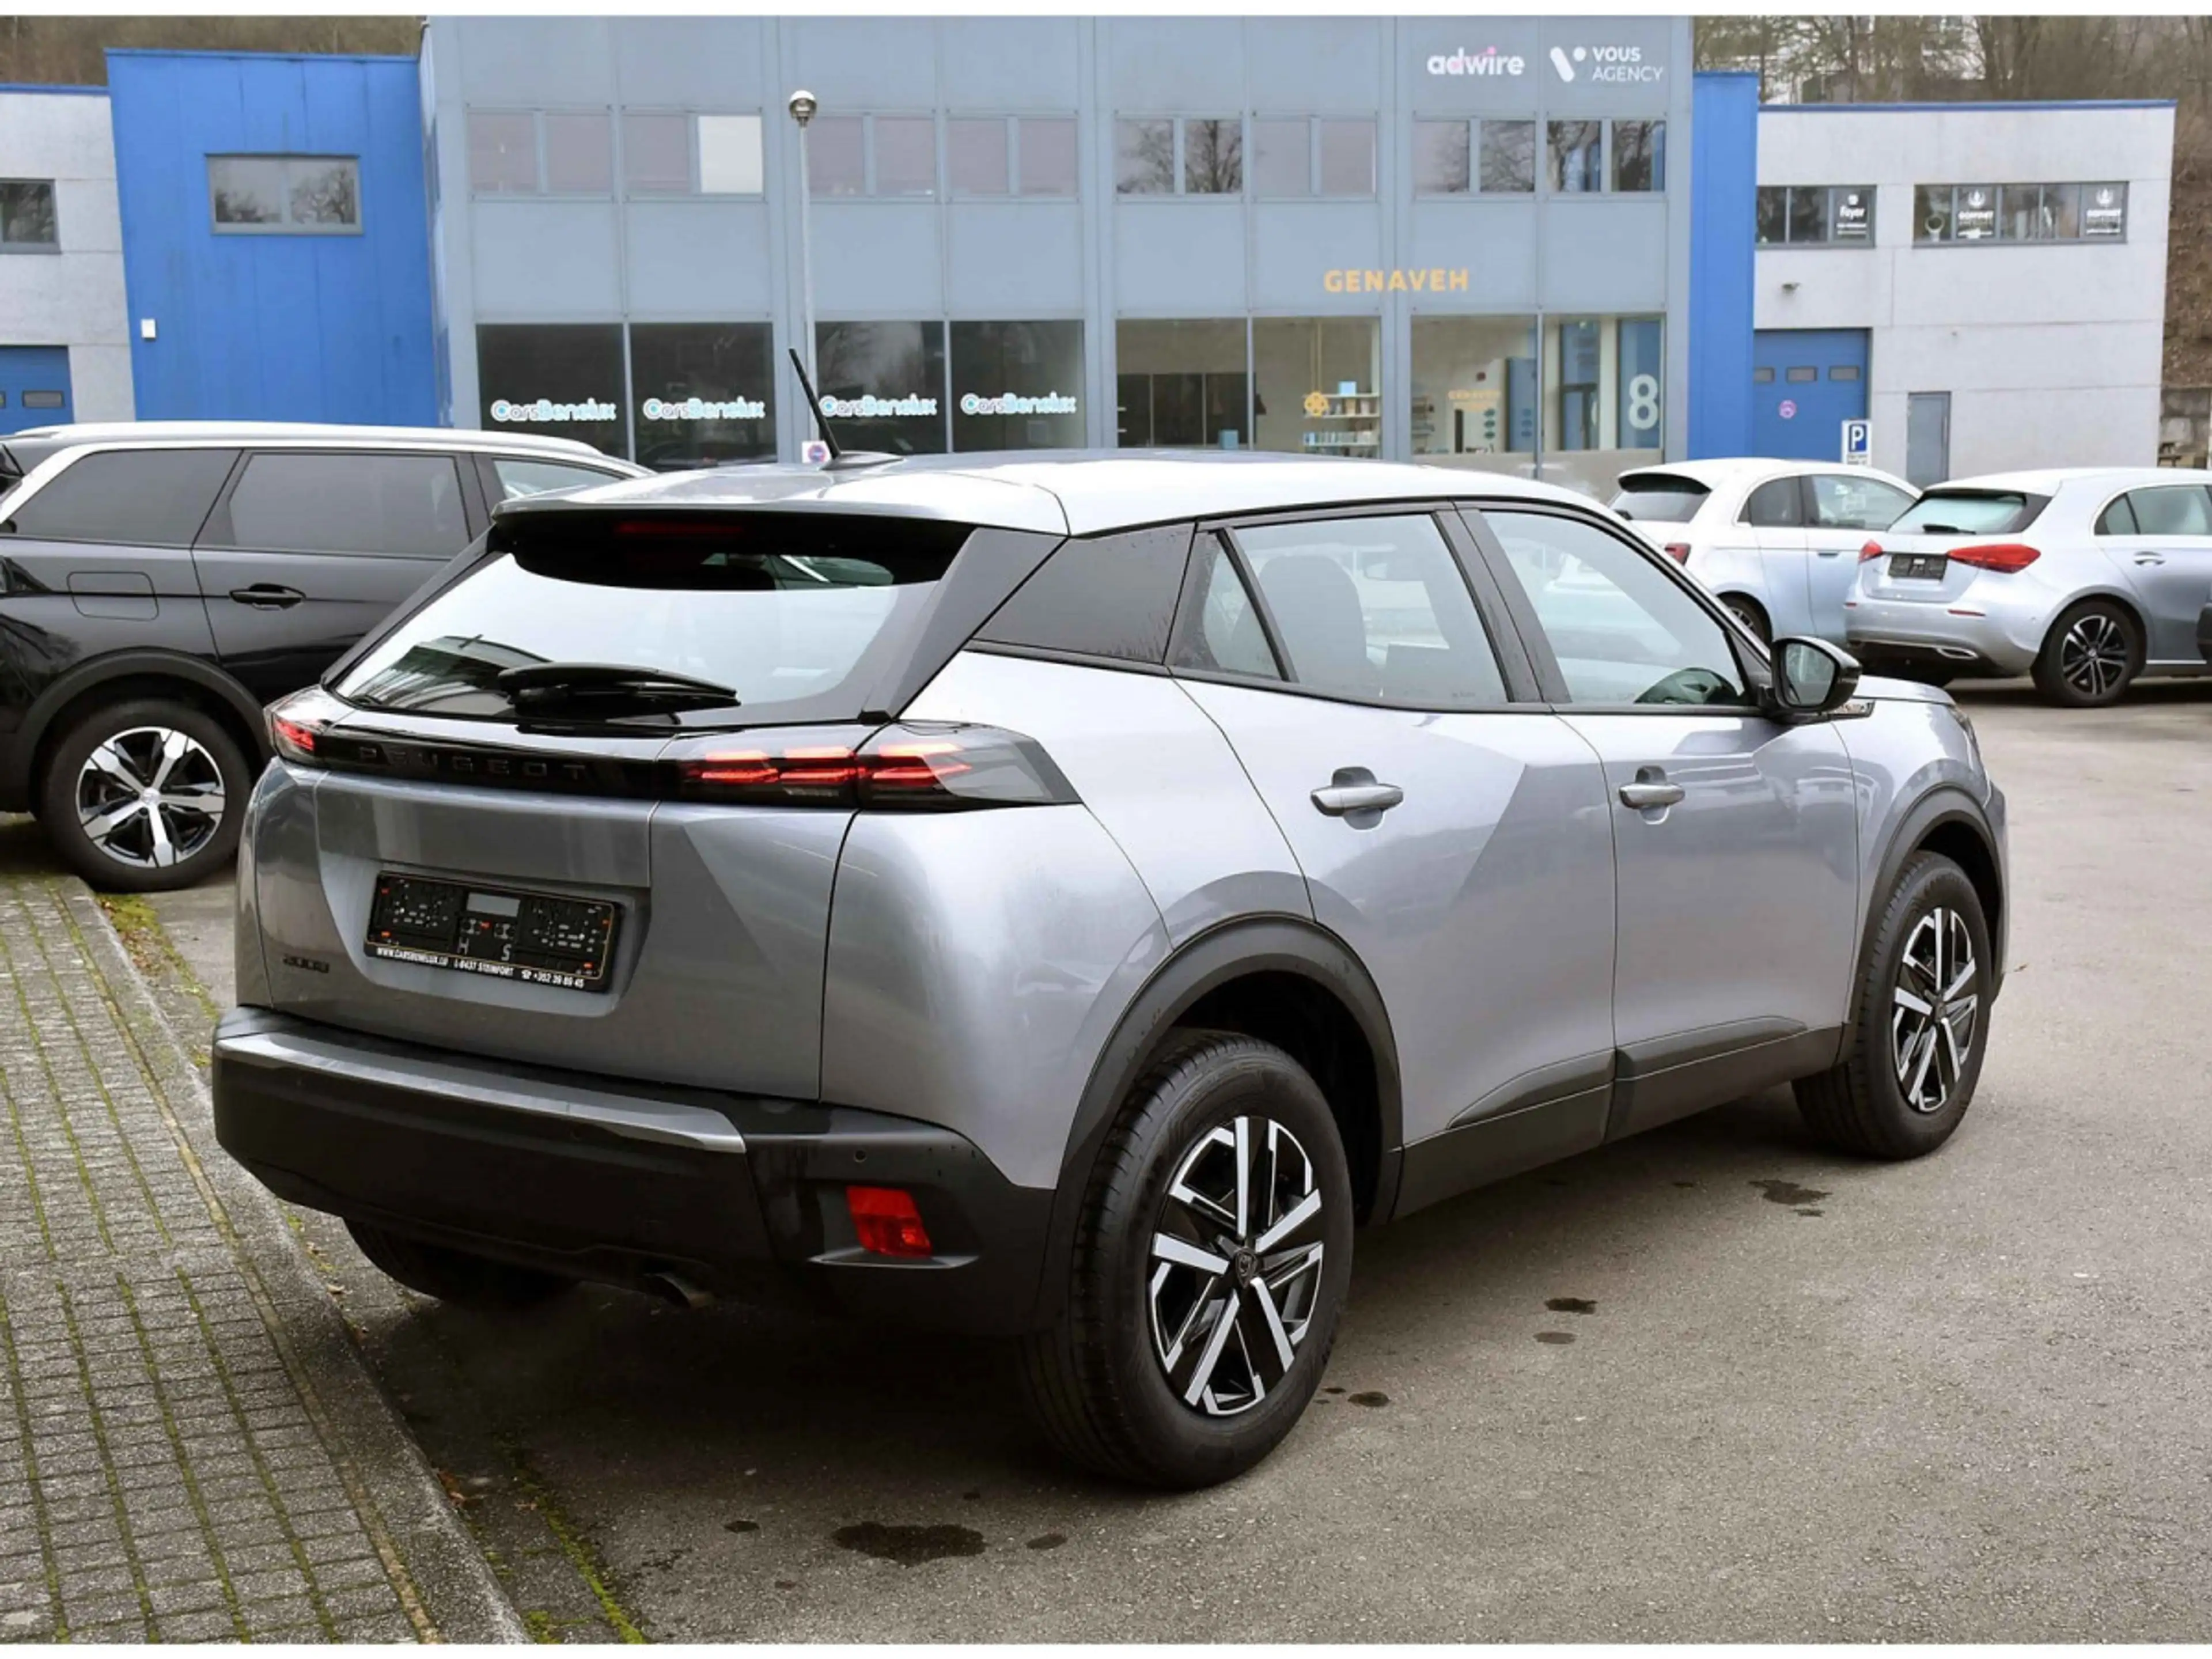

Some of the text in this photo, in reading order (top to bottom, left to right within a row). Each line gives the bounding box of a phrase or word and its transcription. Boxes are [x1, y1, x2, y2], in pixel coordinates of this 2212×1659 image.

[1427, 46, 1525, 76] adwire
[1592, 46, 1642, 63] VOUS
[1592, 65, 1664, 82] AGENCY
[1324, 268, 1469, 293] GENAVEH
[490, 397, 617, 422] CarsBenelux
[642, 396, 765, 421] CarsBenelux
[819, 393, 937, 417] CarsBenelux
[960, 390, 1077, 415] CarsBenelux
[1628, 373, 1658, 430] 8
[1851, 425, 1863, 451] P
[359, 746, 586, 781] PEUGEOT
